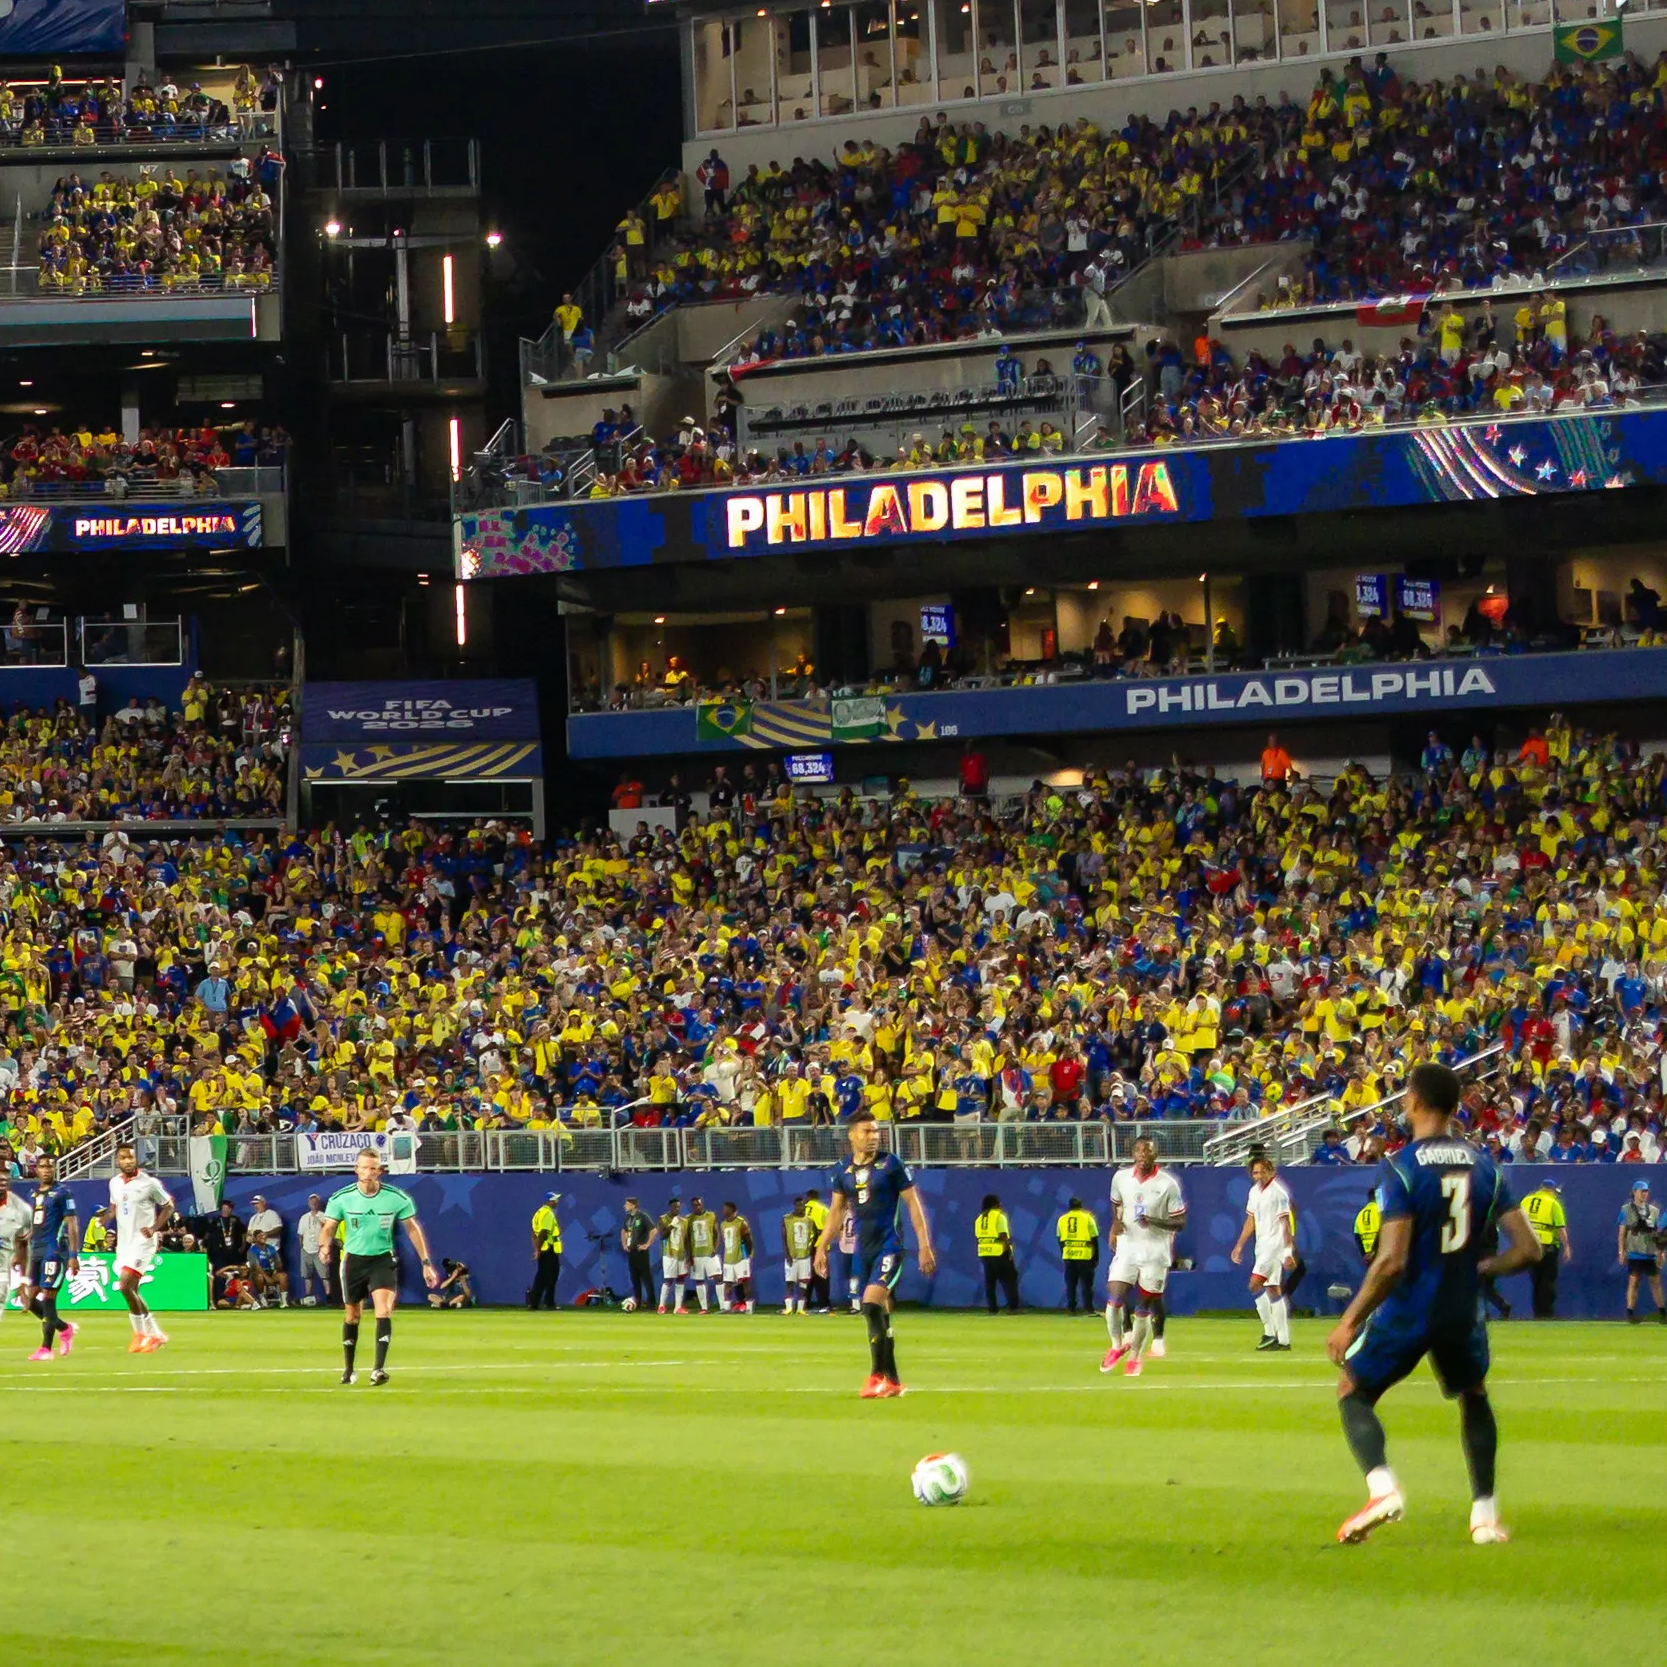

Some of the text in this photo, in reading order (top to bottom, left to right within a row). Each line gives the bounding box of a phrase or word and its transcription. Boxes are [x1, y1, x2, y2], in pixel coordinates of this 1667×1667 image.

[727, 460, 1179, 548] PHILADELPHIA
[75, 516, 236, 538] PHILADELPHIA
[1127, 668, 1496, 715] PHILADELPHIA
[327, 707, 513, 721] WORLD CUP
[385, 700, 453, 710] FIFA
[363, 719, 474, 730] 2026
[1415, 1146, 1475, 1166] GABRIEL
[1440, 1170, 1471, 1254] 3
